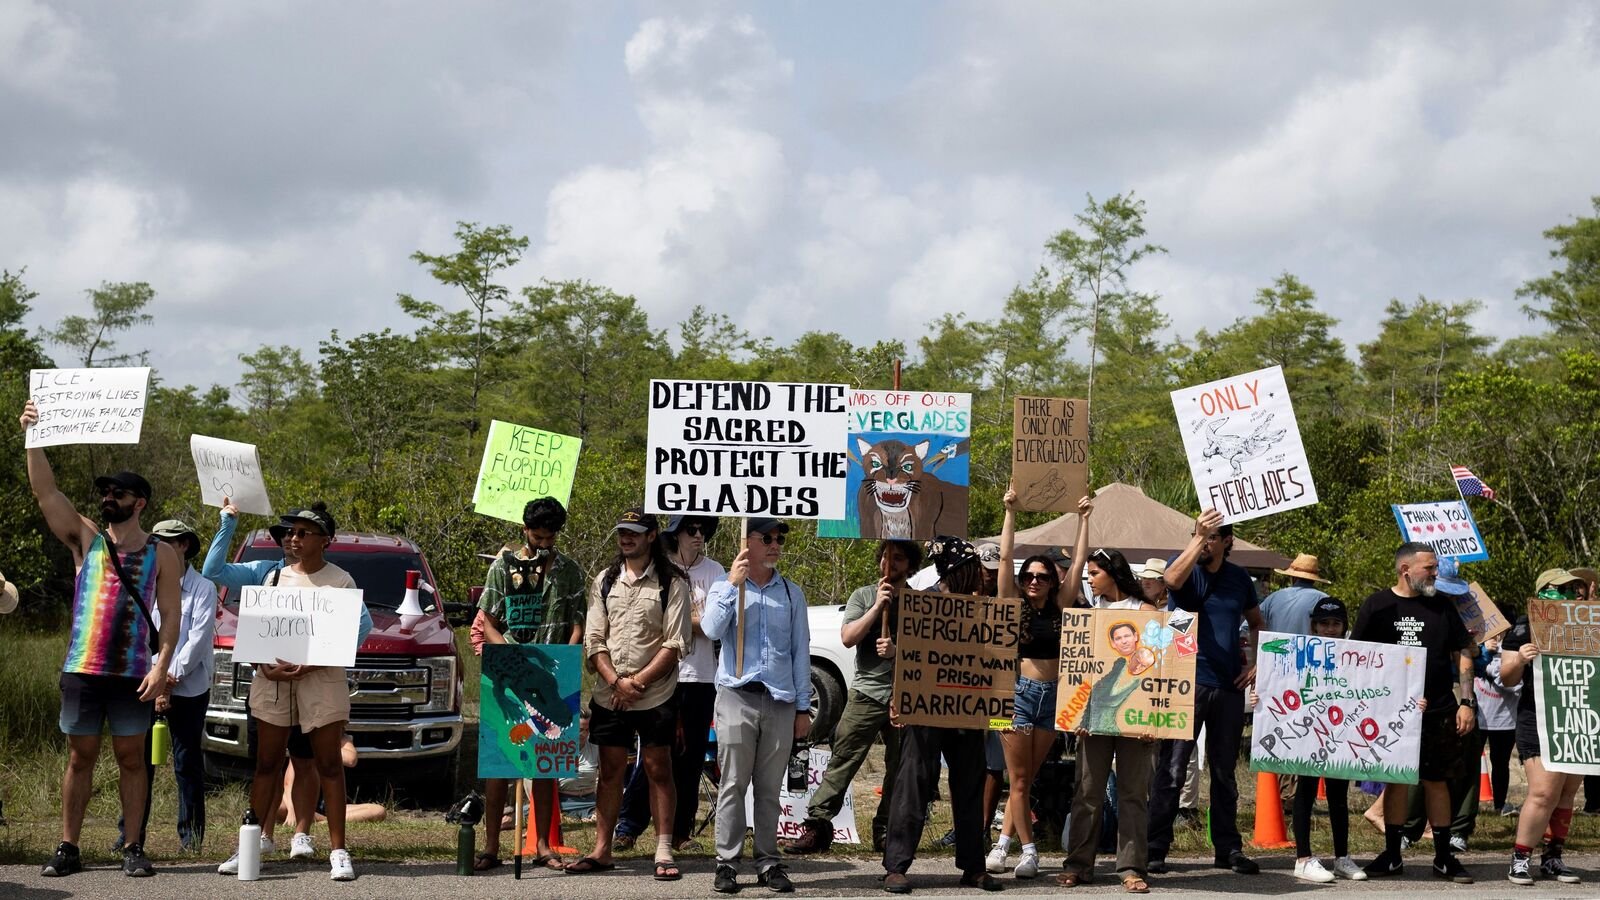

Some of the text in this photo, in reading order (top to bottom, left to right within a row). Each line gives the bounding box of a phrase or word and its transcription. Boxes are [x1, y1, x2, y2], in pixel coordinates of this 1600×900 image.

[32, 390, 140, 406] DESTROYING LIVES
[652, 381, 846, 413] DEFEND THE
[848, 392, 960, 407] NDS OFF OUR
[1019, 398, 1075, 418] THERE IS
[1200, 379, 1259, 416] ONLY
[36, 407, 144, 424] ESTROYING FAMILIES
[102, 420, 135, 433] LAND
[1022, 416, 1074, 436] ONLY ONE
[683, 416, 806, 443] SACRED
[509, 425, 563, 458] KEEP
[1016, 439, 1086, 464] EVERGLADES
[491, 452, 562, 479] FLORIDA
[655, 447, 847, 478] PROTECT THE
[508, 474, 550, 496] WILD
[1209, 466, 1305, 517] EVERGLADES
[657, 482, 819, 517] GLADES
[1403, 509, 1467, 523] THANK YOU
[1424, 537, 1478, 555] MIGRANTS
[245, 588, 334, 614] Defend the
[903, 593, 1015, 622] RESTORE THE
[1063, 612, 1092, 627] PUT
[1530, 600, 1600, 625] NO ICE
[903, 617, 1020, 648] EVERGLADES
[1063, 630, 1090, 645] THE
[902, 650, 922, 663] WE
[928, 650, 976, 667] DONT
[1061, 646, 1095, 659] REAL
[903, 668, 993, 687] NO PRISON
[1060, 660, 1105, 674] FELONS
[1549, 657, 1595, 685] KEEP
[1068, 674, 1083, 686] IN
[1140, 677, 1191, 695] GTFO
[1323, 673, 1348, 688] the
[900, 692, 1015, 717] BARRICADE
[1056, 680, 1092, 731] PRISON
[1149, 697, 1170, 708] THE
[1267, 689, 1301, 722] NO
[1557, 685, 1590, 708] THE
[1124, 708, 1188, 729] GLADES
[1313, 705, 1344, 747] NO
[1552, 706, 1600, 735] LAND
[534, 740, 577, 755] HANDS
[1347, 717, 1380, 759] NO
[1552, 733, 1600, 762] SACRE
[536, 755, 579, 773] OFF!
